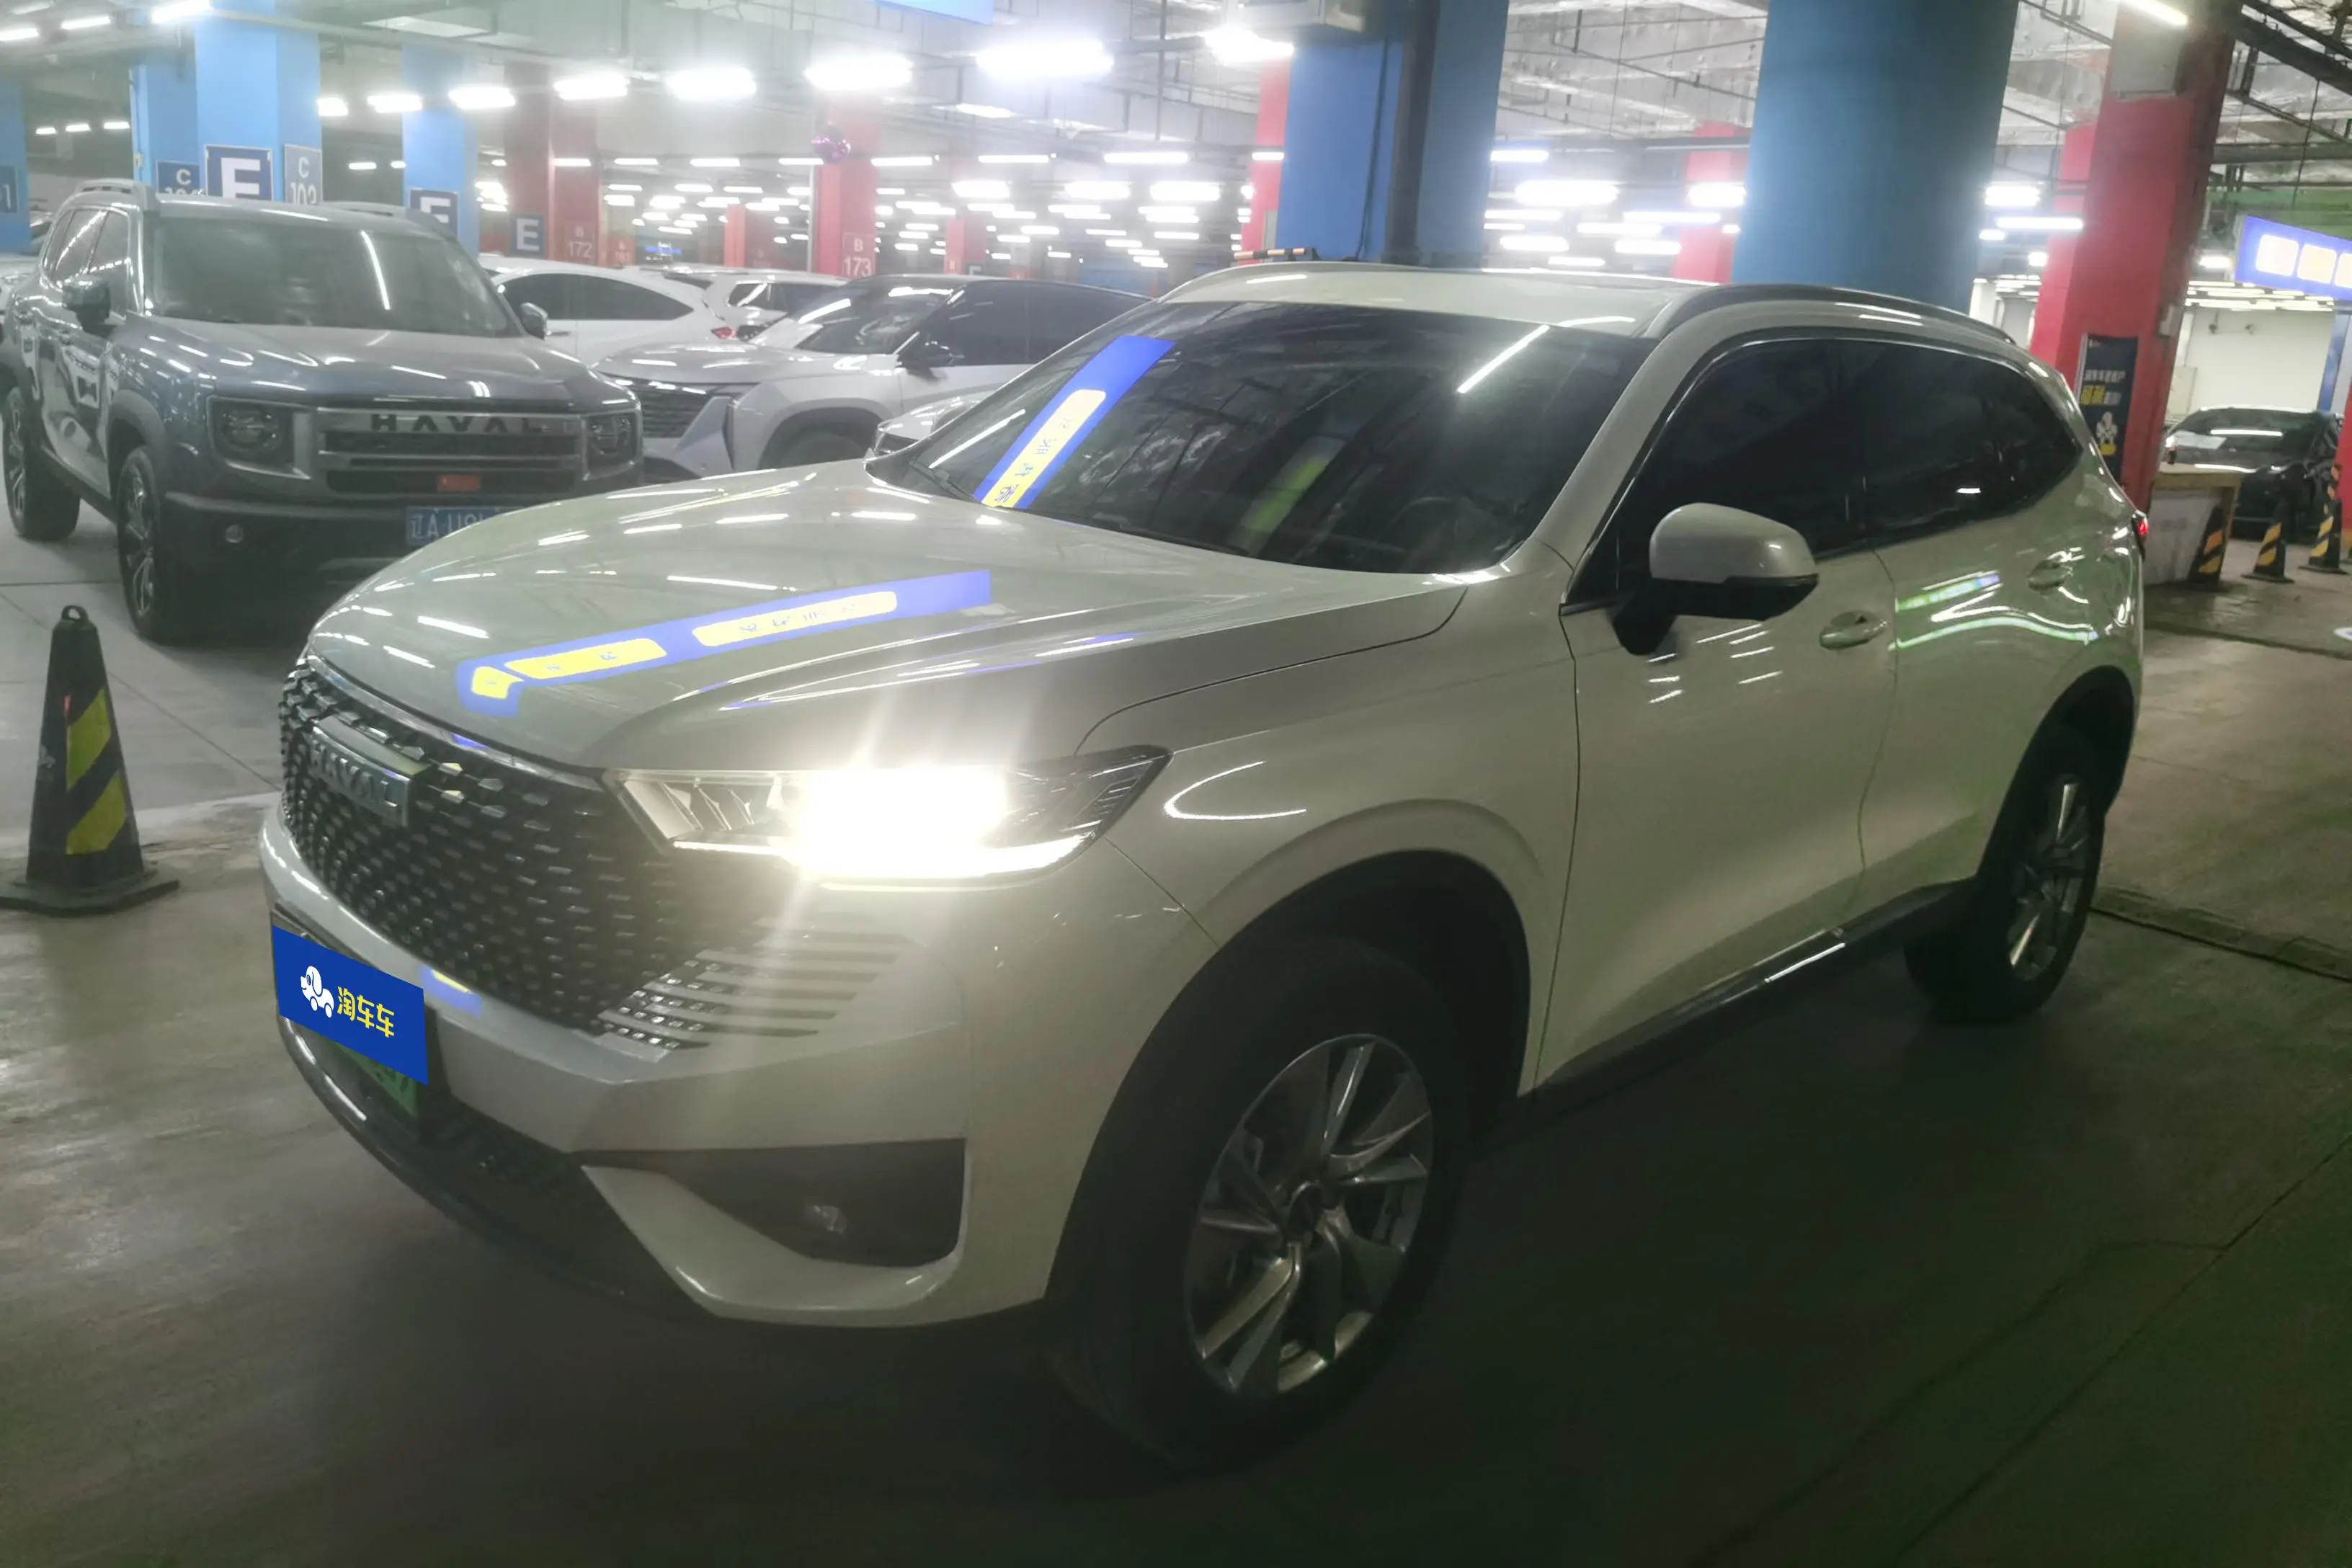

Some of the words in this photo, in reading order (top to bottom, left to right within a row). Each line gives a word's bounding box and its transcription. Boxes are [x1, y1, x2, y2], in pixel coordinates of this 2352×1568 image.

[298, 156, 310, 178] C
[176, 169, 192, 185] C
[516, 218, 540, 251] E
[568, 241, 594, 259] 172
[853, 239, 864, 251] B
[844, 257, 873, 277] 173
[370, 414, 551, 432] HAVAL
